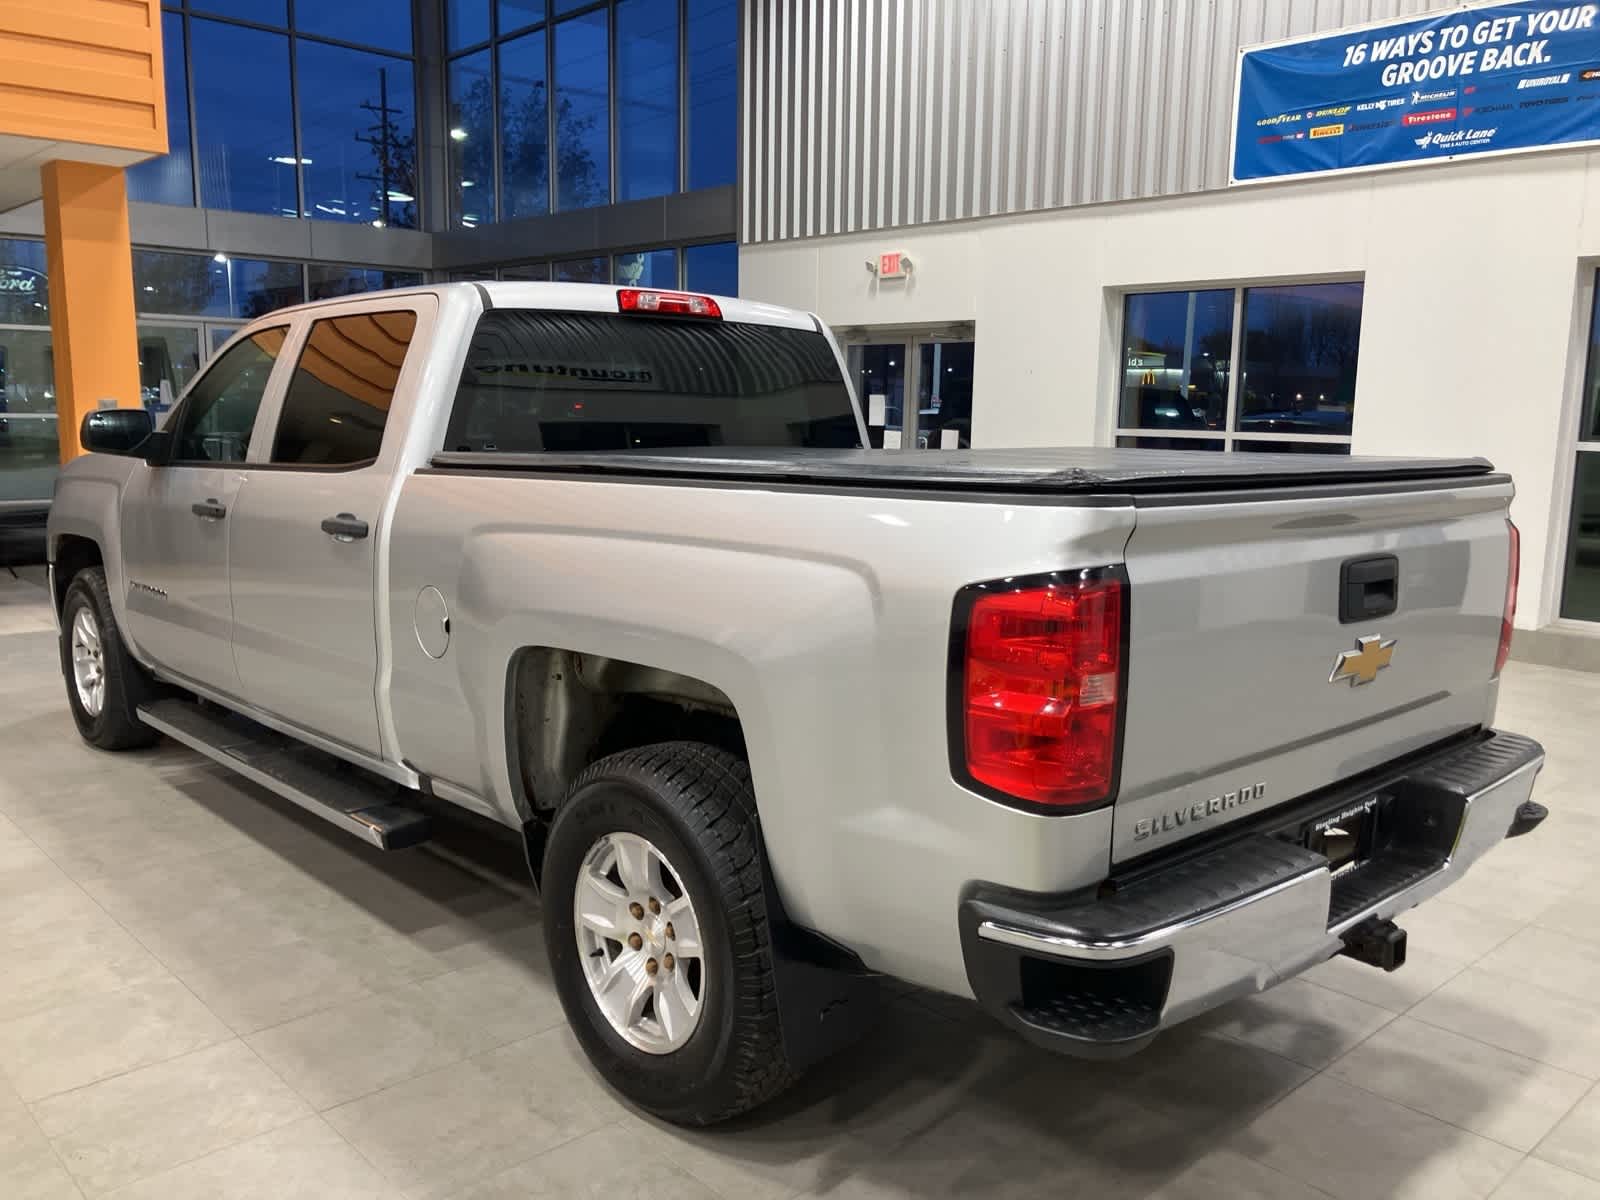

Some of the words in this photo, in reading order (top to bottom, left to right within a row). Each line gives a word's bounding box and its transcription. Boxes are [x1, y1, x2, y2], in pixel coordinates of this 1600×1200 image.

[1343, 42, 1368, 67] 16
[1370, 30, 1435, 62] WAYS
[1439, 25, 1469, 51] TO
[1472, 15, 1522, 45] GET
[1527, 5, 1596, 36] YOUR
[1381, 51, 1478, 87] GROOVE
[1480, 40, 1552, 71] BACK.
[1256, 113, 1302, 126] GOODYEAR
[1408, 110, 1452, 124] Firestone
[1432, 130, 1465, 144] Quick
[1465, 128, 1496, 140] Lane
[881, 254, 900, 274] EXIT
[1134, 781, 1267, 841] SILVERADO
